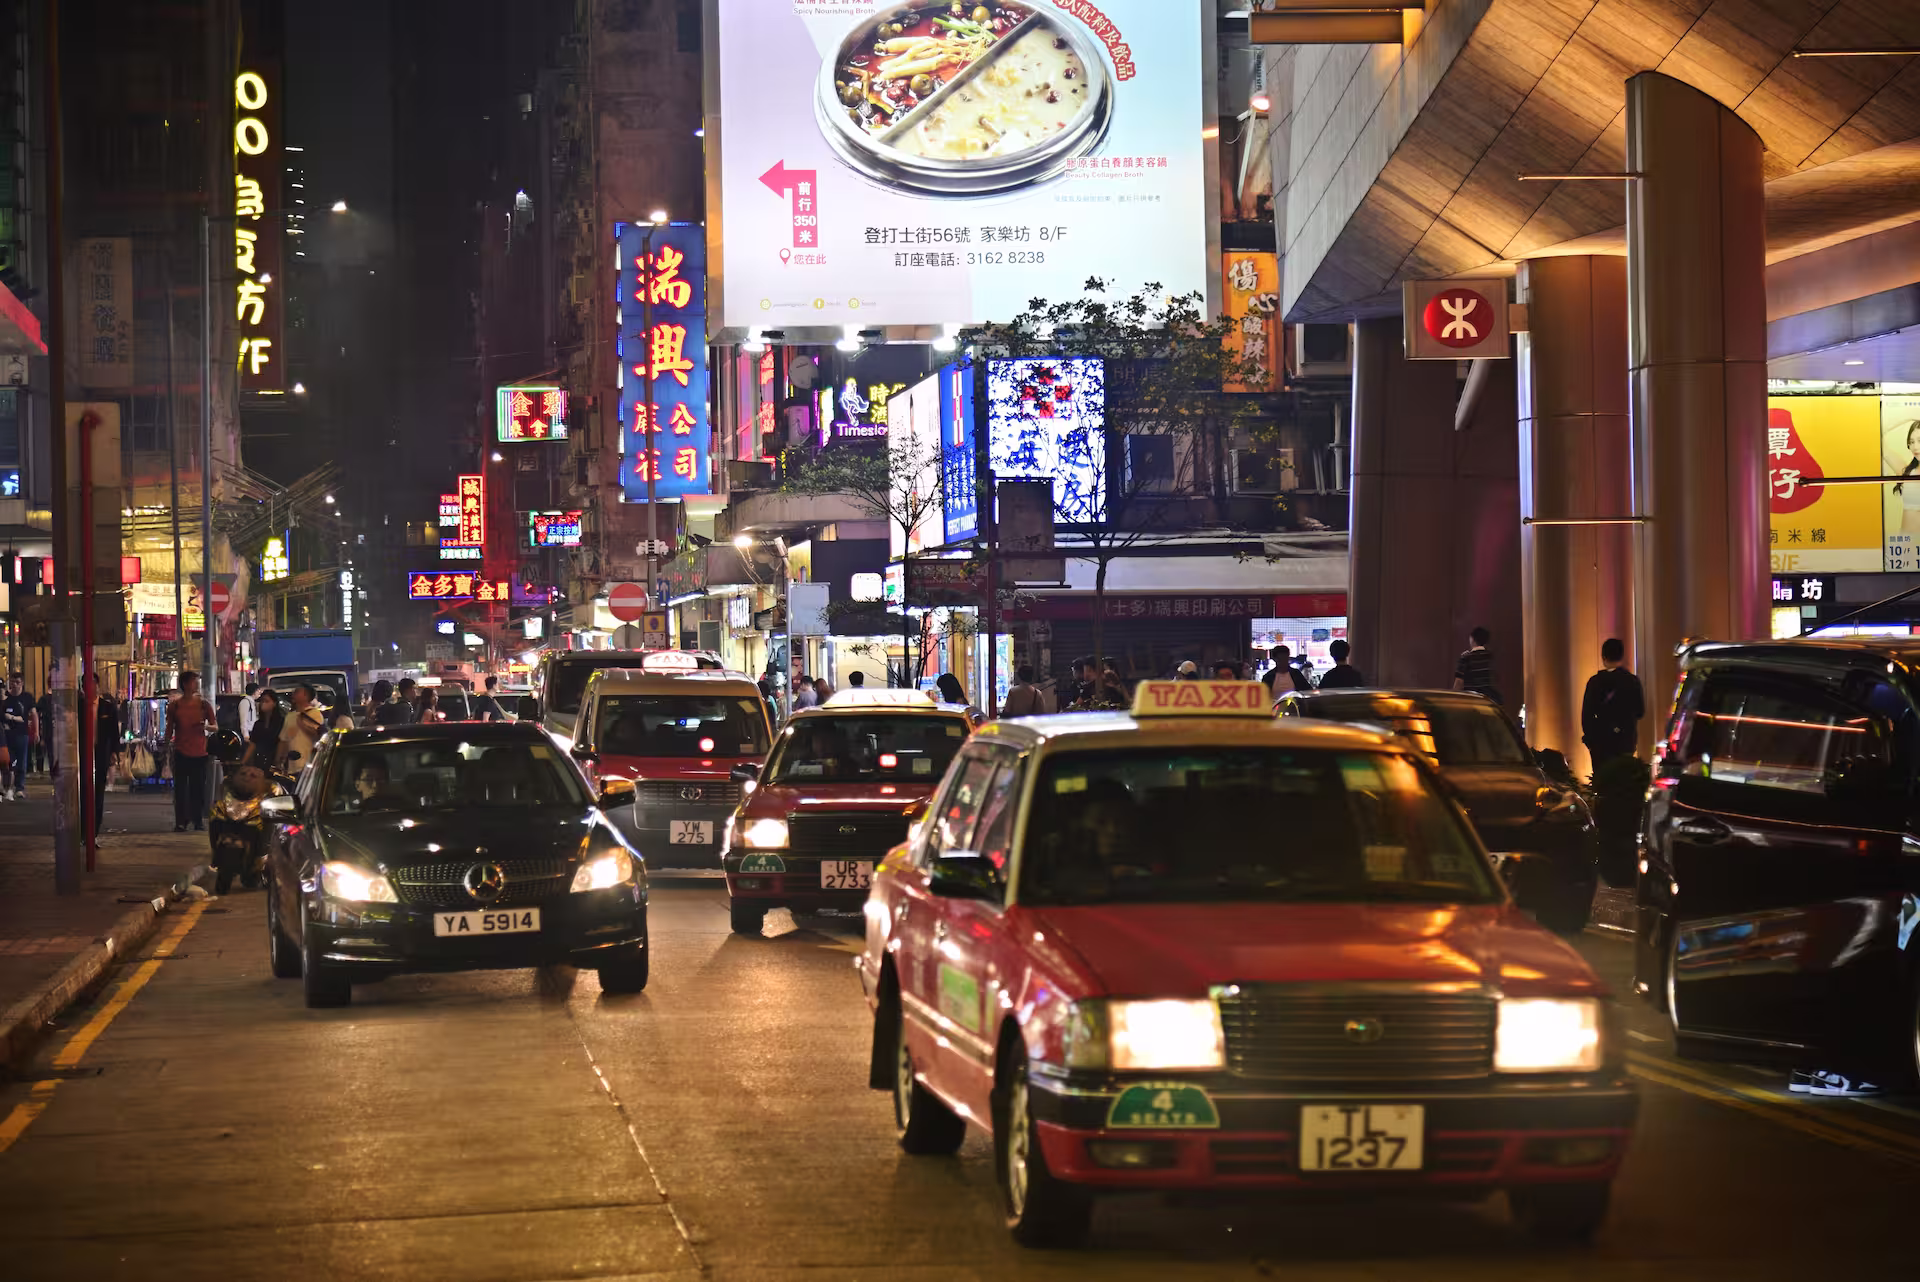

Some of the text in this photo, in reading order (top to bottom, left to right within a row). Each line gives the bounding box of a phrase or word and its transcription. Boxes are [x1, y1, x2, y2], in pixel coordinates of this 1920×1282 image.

[814, 7, 854, 15] Nourishing
[1065, 171, 1090, 179] Beauty
[1092, 171, 1122, 179] Collagen
[864, 226, 1068, 245] 登打士街56號 家樂坊 8/F
[793, 254, 827, 265] 您在此
[894, 251, 1045, 267] 訂座電話: 3162 8238
[670, 402, 697, 482] 公司
[1889, 545, 1911, 556] 10/F
[1889, 559, 1910, 570] 12/F
[412, 574, 473, 597] 金多寶
[654, 655, 689, 663] TAXI
[1149, 684, 1264, 709] TAXI
[682, 821, 700, 832] YW
[677, 832, 705, 844] 275
[757, 856, 767, 866] 4
[836, 861, 859, 875] UR
[825, 874, 871, 889] 2733
[443, 911, 533, 932] YA 5914
[1151, 1090, 1175, 1112] 4
[1337, 1106, 1387, 1138] TL
[1316, 1137, 1408, 1169] 1237
